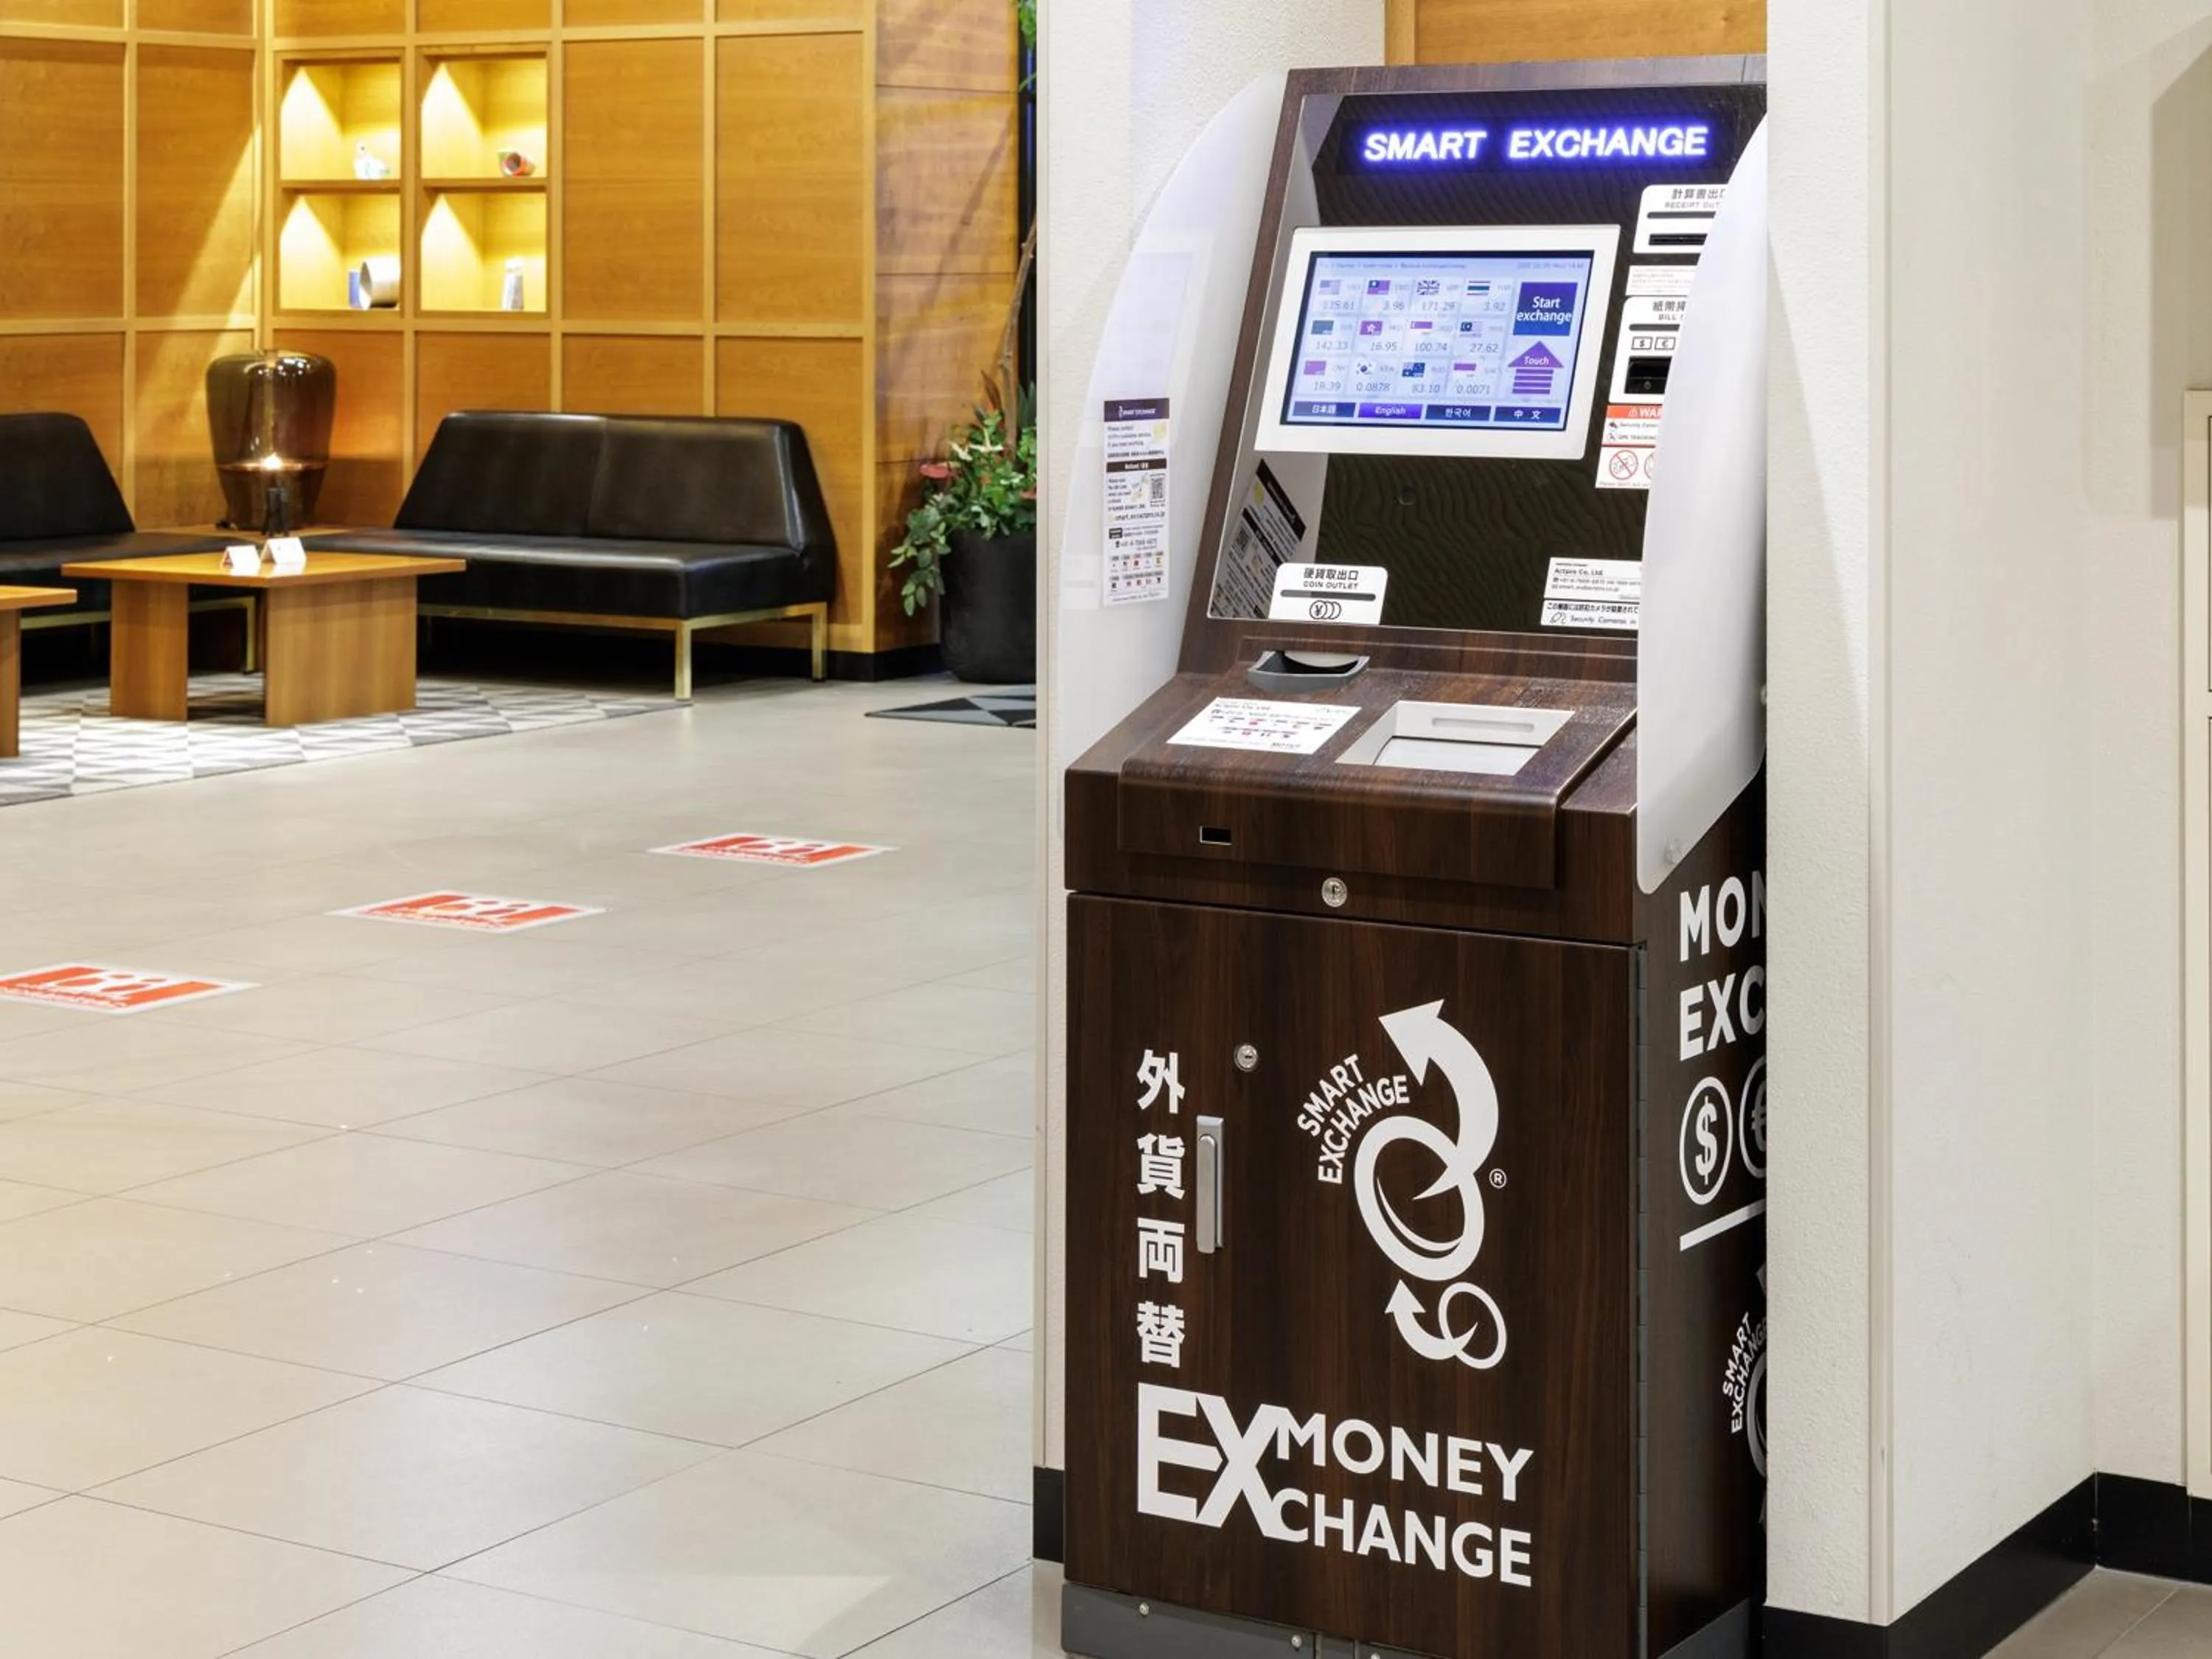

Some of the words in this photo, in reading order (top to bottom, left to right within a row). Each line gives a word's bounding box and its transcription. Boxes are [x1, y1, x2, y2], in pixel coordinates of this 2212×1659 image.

[1364, 130, 1487, 161] SMART
[1509, 126, 1709, 159] EXCHANGE
[1532, 296, 1560, 308] Start
[1517, 310, 1573, 325] exchange
[1369, 341, 1398, 352] 16.95
[1413, 341, 1447, 352] 100.74
[1469, 343, 1499, 353] 27.62
[1523, 356, 1549, 366] Touch
[1455, 384, 1491, 395] 0.0071
[1312, 404, 1337, 414] 日本語
[1374, 406, 1407, 417] English
[1444, 408, 1472, 419] 한국어
[1303, 567, 1359, 581] 硬貨取出口
[1325, 582, 1359, 590] OUTLET
[1298, 1054, 1364, 1137] SMART
[1318, 1074, 1410, 1184] EXCHANGE
[1136, 1049, 1186, 1368] 外貨両替
[1722, 1311, 1751, 1397] SMART
[1276, 1406, 1534, 1501] MONEY
